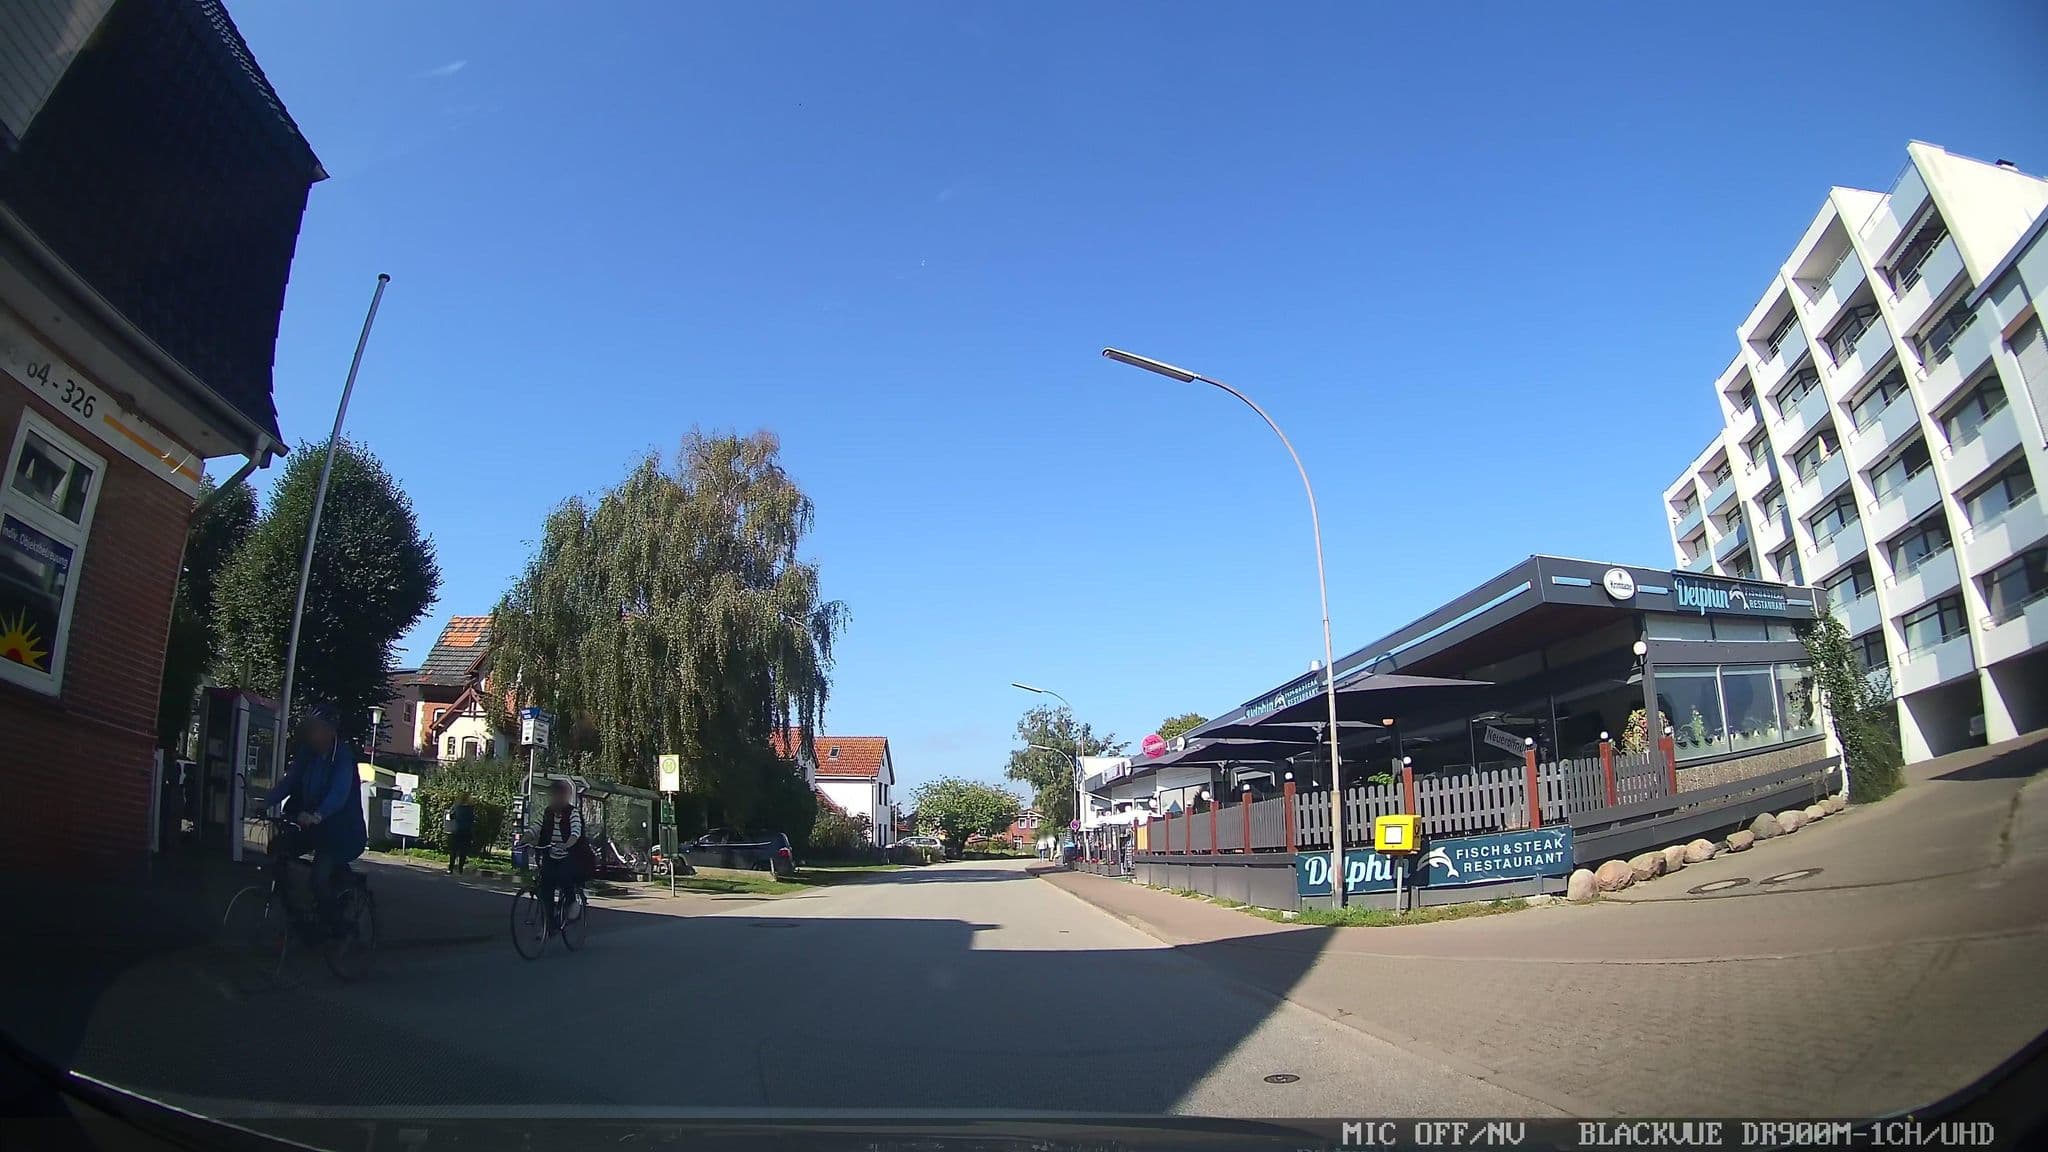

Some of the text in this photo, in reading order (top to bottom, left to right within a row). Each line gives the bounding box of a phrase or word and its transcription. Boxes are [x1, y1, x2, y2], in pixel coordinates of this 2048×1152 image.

[60, 378, 97, 419] 326
[1674, 577, 1730, 616] Delphin
[1749, 599, 1786, 611] RESTAURANT
[1456, 838, 1564, 860] FISCH&STEAK
[1463, 851, 1564, 873] RESTAURANT
